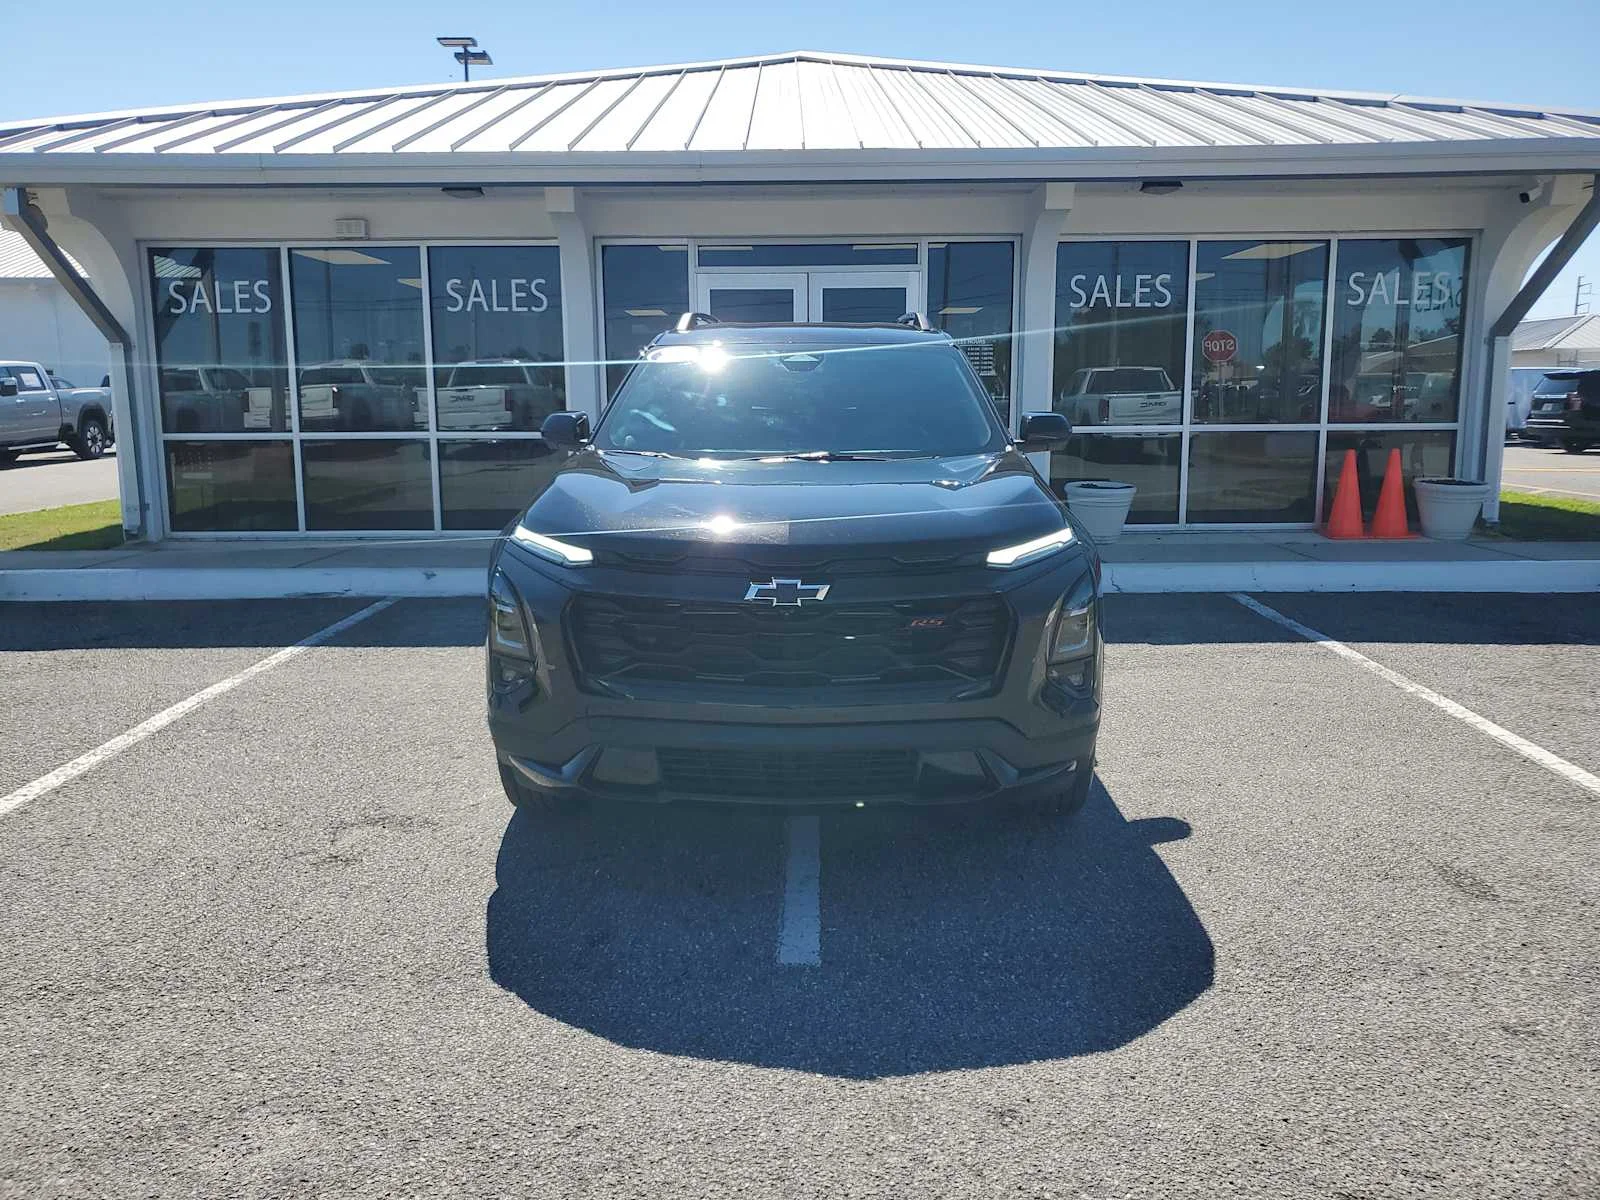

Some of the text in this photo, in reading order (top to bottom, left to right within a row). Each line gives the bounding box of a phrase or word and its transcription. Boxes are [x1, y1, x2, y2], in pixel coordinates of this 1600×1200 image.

[168, 280, 272, 314] SALES
[446, 278, 549, 313] SALES
[1069, 273, 1172, 308] SALES
[1347, 271, 1451, 306] SALES
